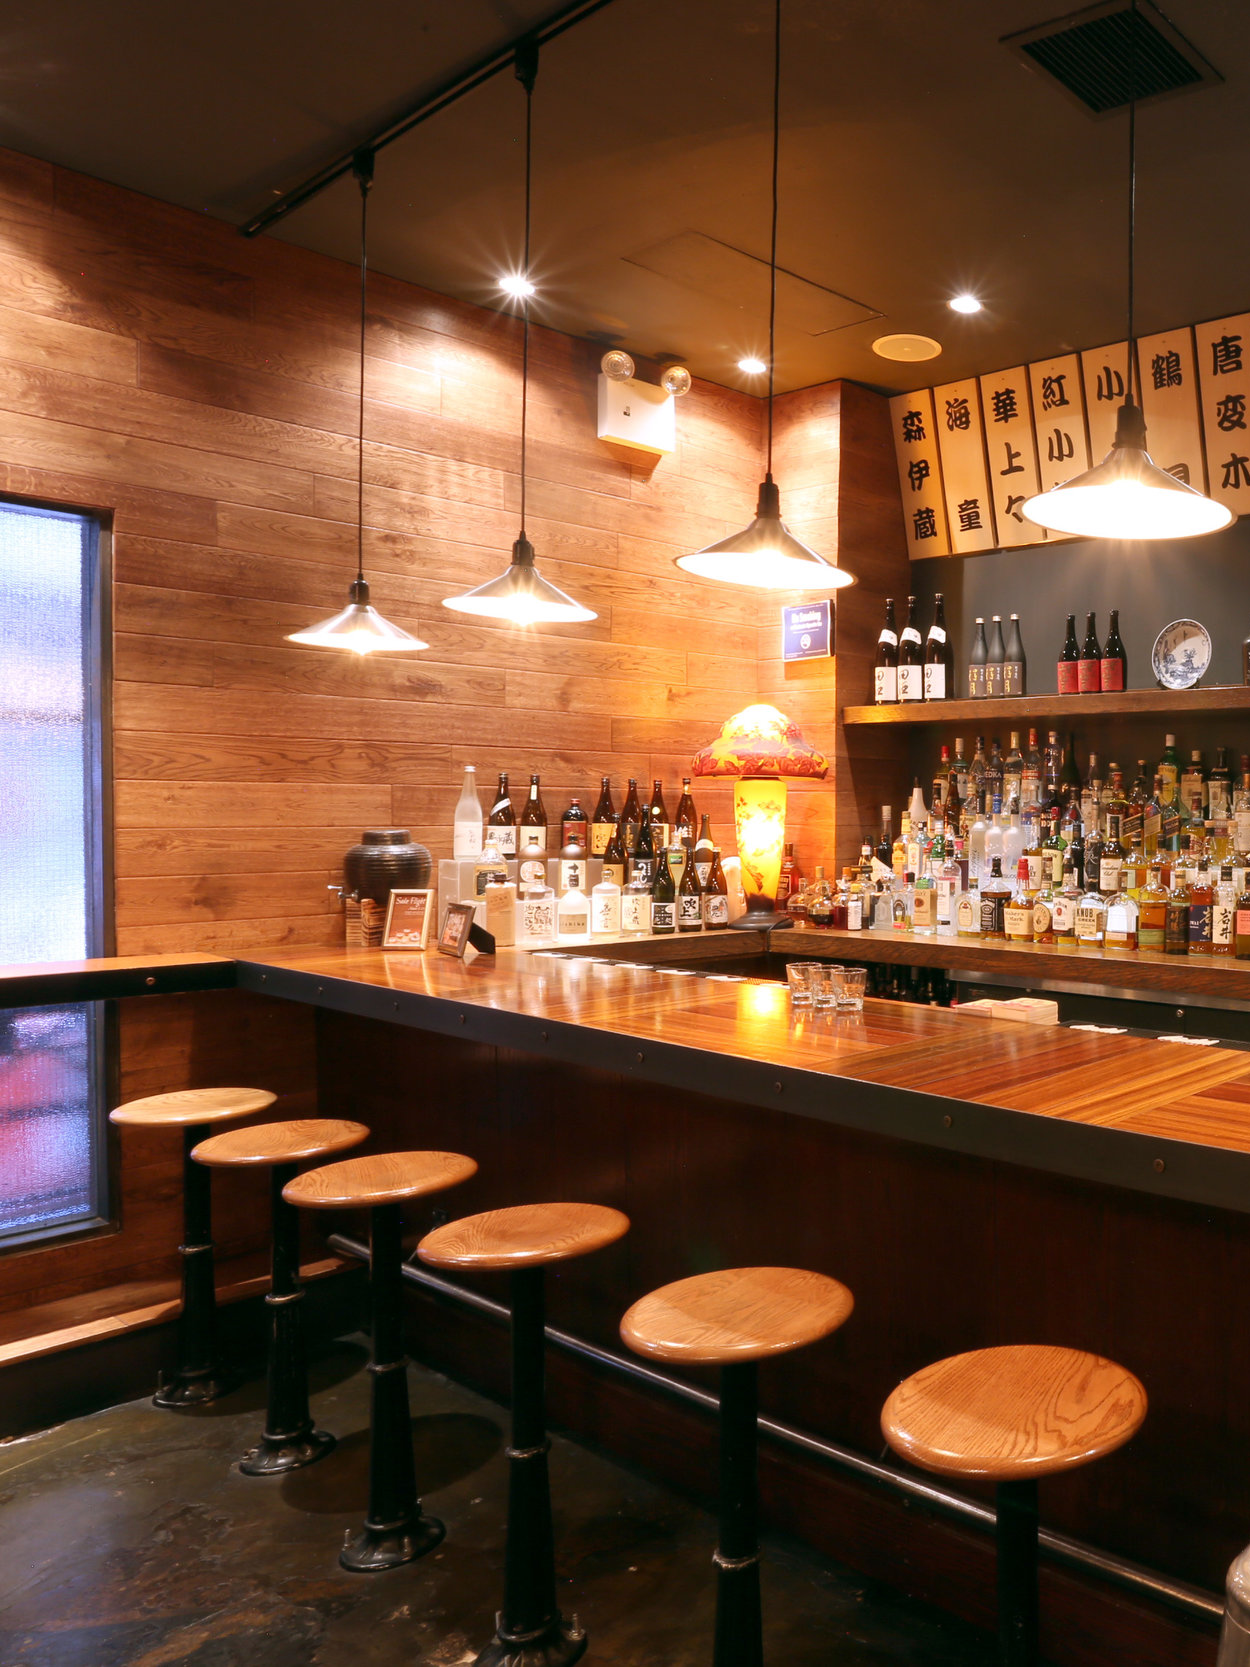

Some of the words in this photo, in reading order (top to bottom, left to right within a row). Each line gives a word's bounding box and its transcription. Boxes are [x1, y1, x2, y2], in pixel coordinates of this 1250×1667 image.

[902, 411, 937, 540] 森伊蔵
[945, 398, 983, 532] 海童
[1041, 374, 1075, 487] 紅小
